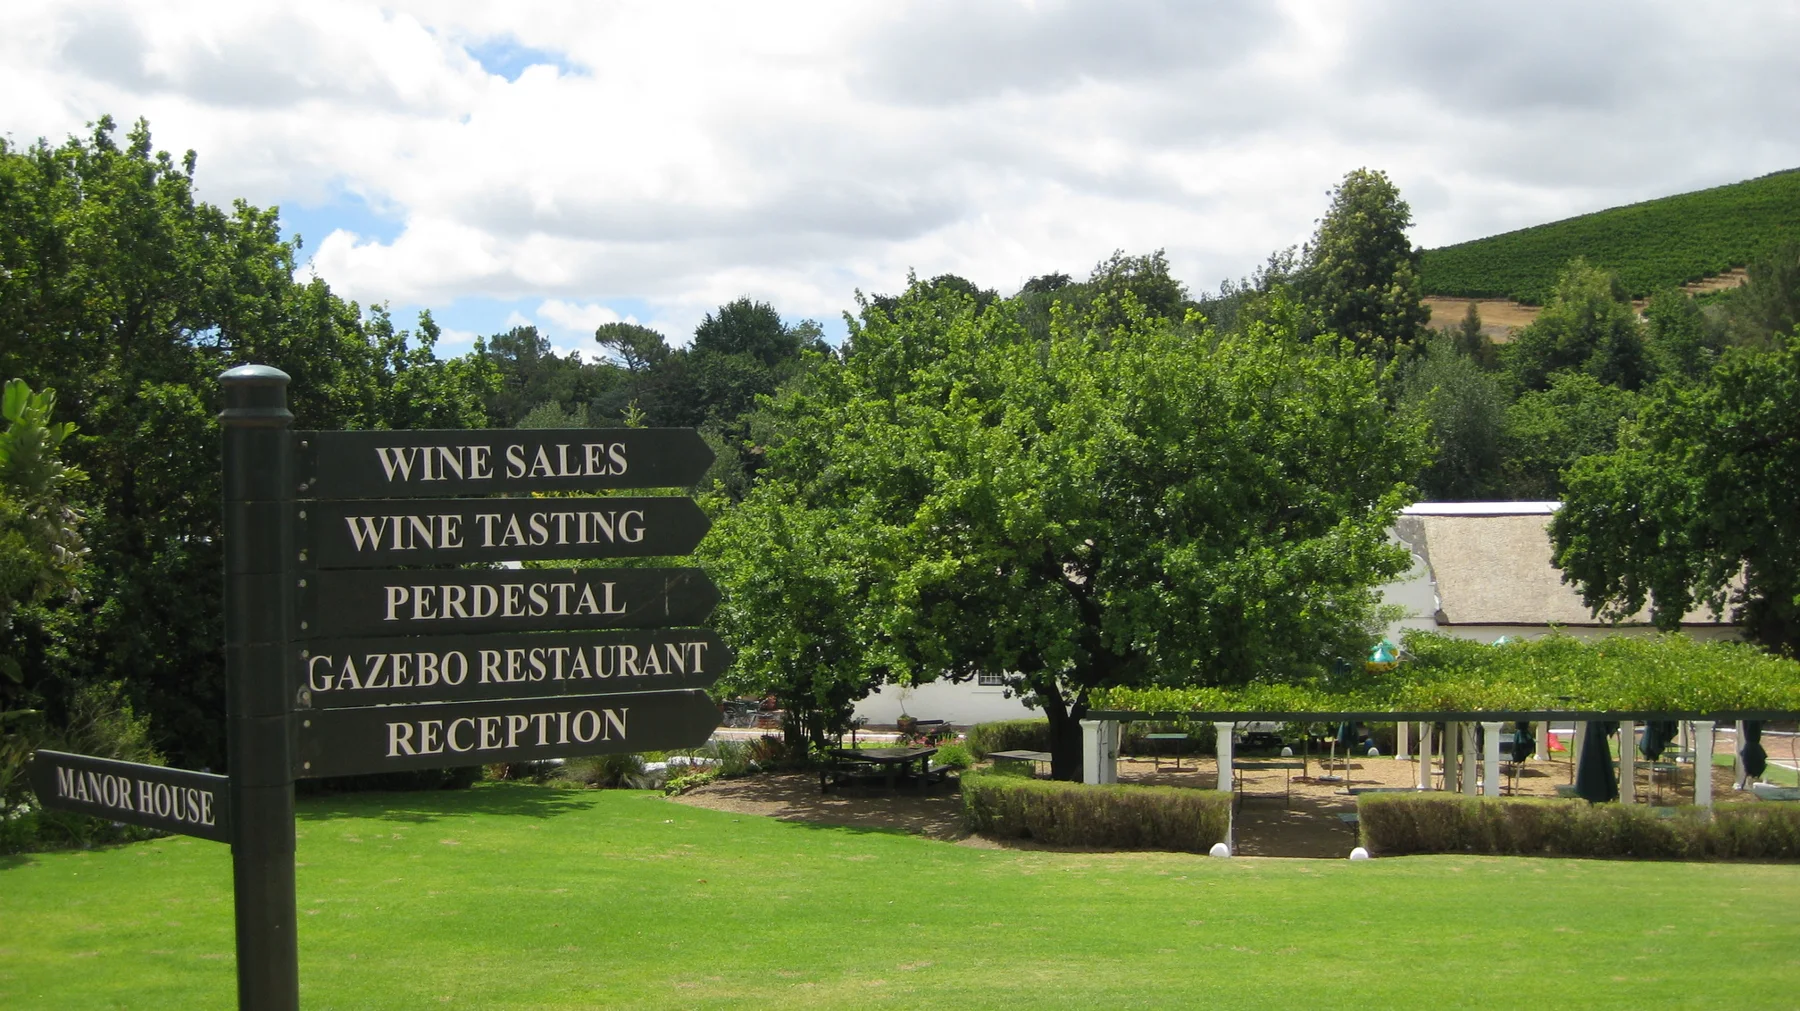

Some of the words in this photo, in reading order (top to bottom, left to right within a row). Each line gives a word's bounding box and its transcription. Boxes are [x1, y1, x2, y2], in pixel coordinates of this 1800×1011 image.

[375, 445, 494, 482] WINE
[506, 442, 628, 479] SALES
[345, 514, 464, 551] WINE
[476, 510, 645, 547] TASTING
[383, 582, 627, 622] PERDESTAL
[309, 651, 468, 692] GAZEBO
[478, 641, 708, 685] RESTAURANT
[386, 707, 628, 757] RECEPTION
[56, 765, 133, 812] MANOR
[138, 780, 216, 826] HOUSE
